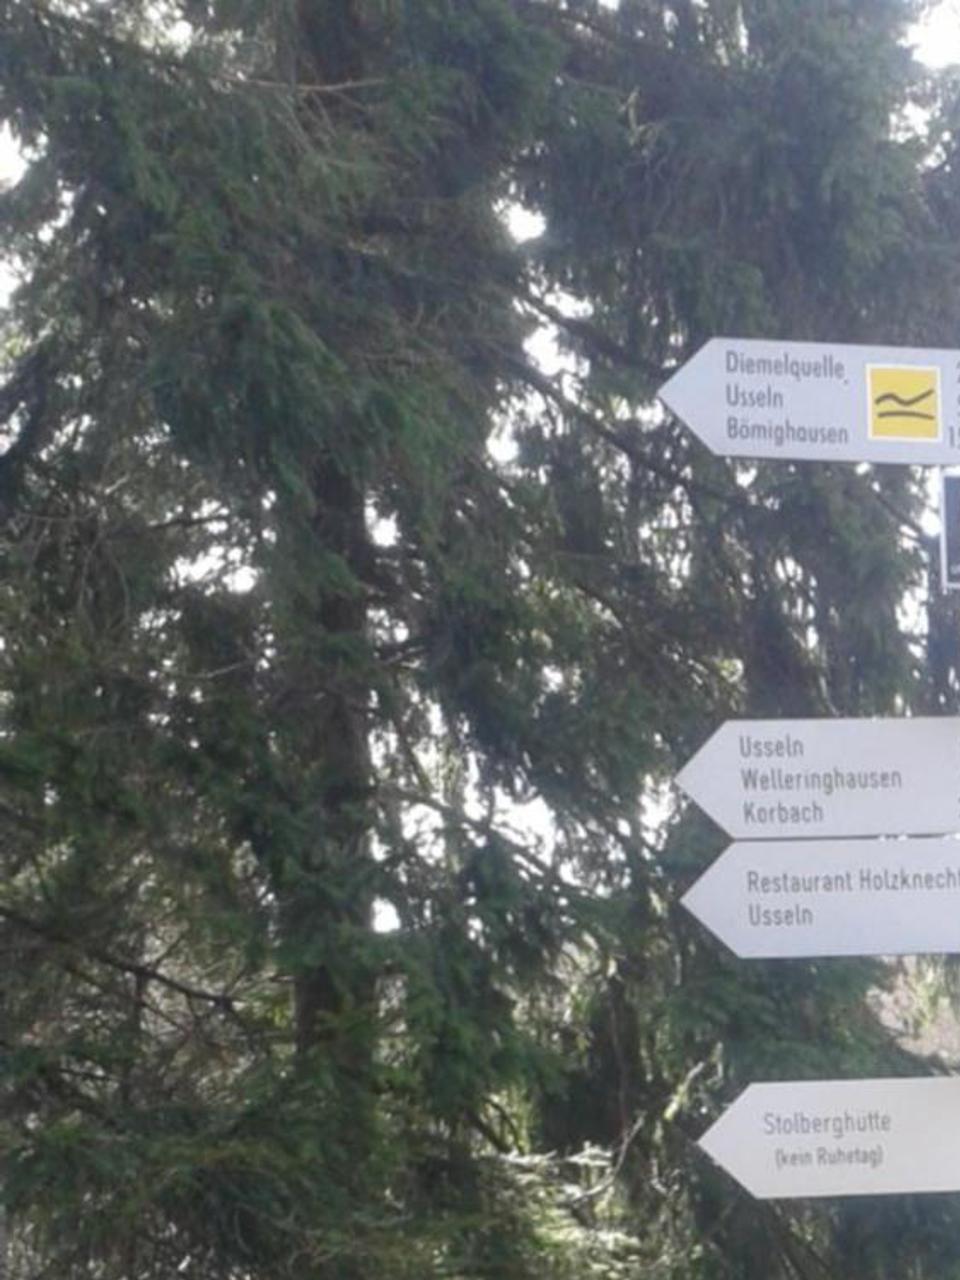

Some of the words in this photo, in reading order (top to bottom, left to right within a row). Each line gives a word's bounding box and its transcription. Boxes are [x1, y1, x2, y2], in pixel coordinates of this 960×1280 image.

[726, 350, 845, 381] Diemelquelle
[726, 383, 784, 408] Usseln
[727, 416, 848, 446] Bömighausen
[739, 734, 804, 758] Usseln
[741, 766, 902, 795] Welleringhausen
[743, 801, 824, 824] Korbach
[747, 870, 853, 893] Restaurant
[749, 903, 814, 927] Usseln
[775, 1147, 813, 1170] (kein
[816, 1145, 883, 1168] Ruhetag)
